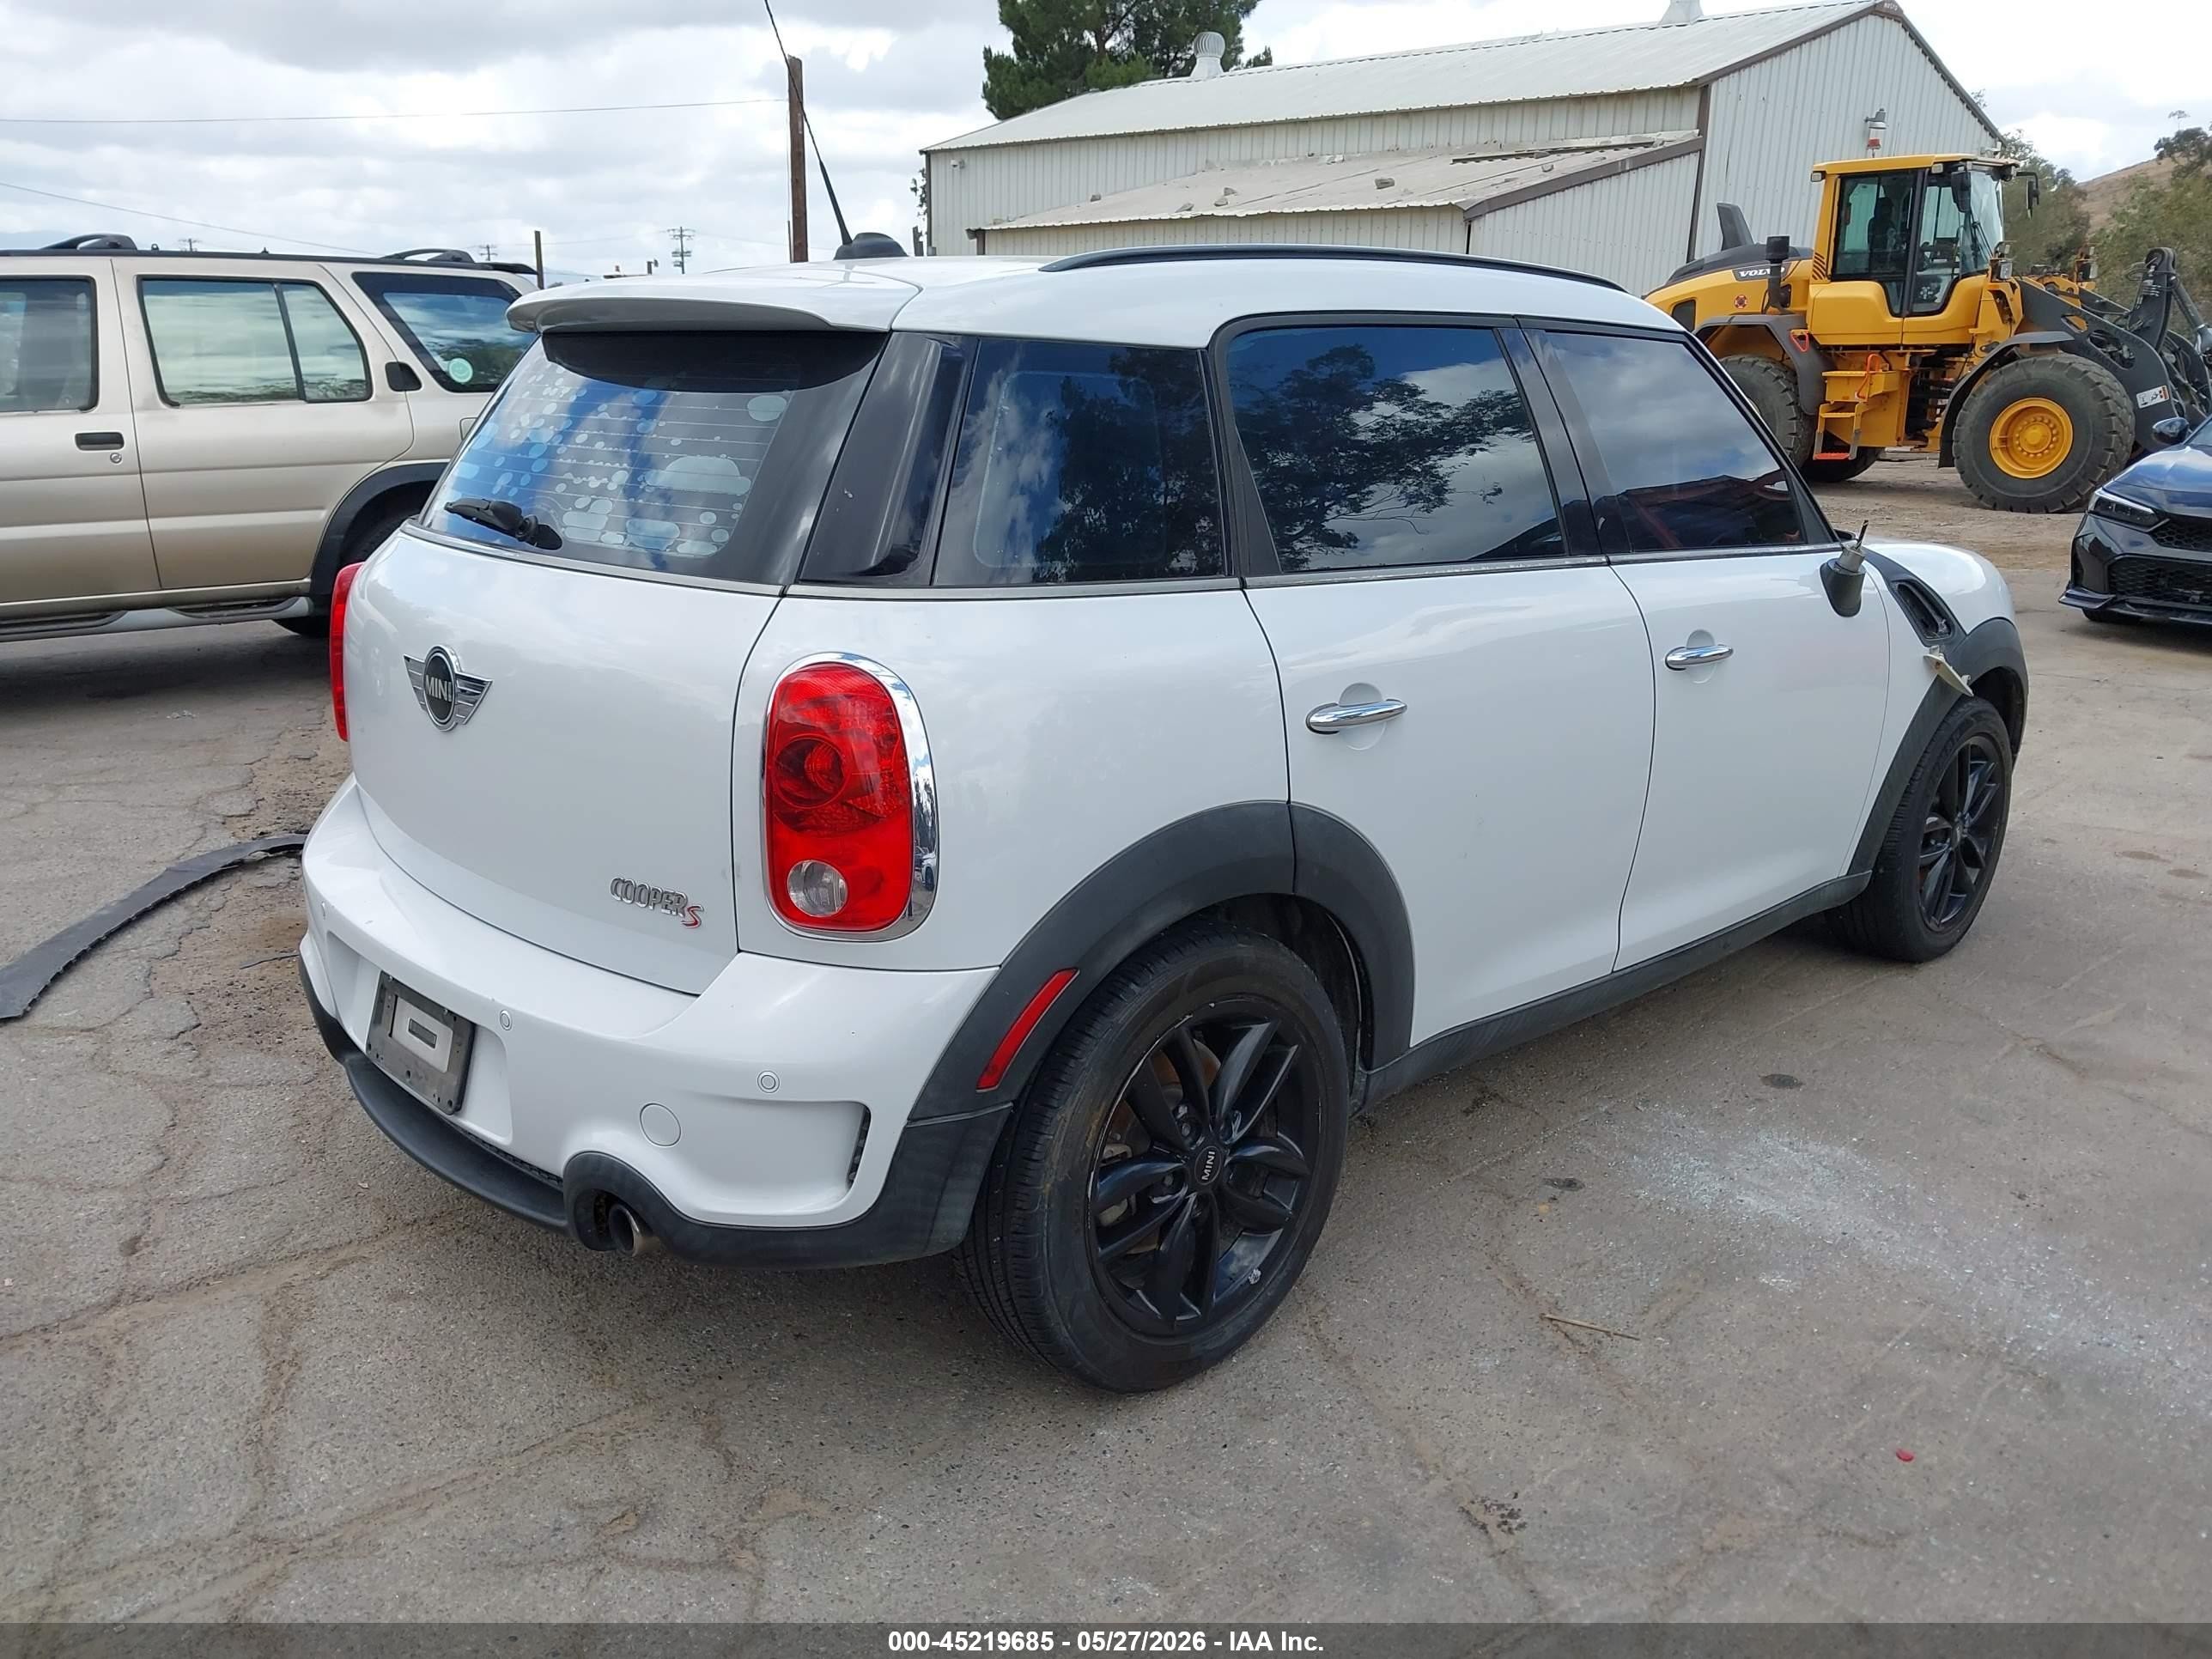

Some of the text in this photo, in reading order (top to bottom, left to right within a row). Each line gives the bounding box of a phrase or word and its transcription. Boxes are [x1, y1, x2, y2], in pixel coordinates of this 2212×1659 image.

[425, 674, 453, 702] MINI
[610, 877, 704, 928] COOPER S
[1201, 1151, 1216, 1181] MINI
